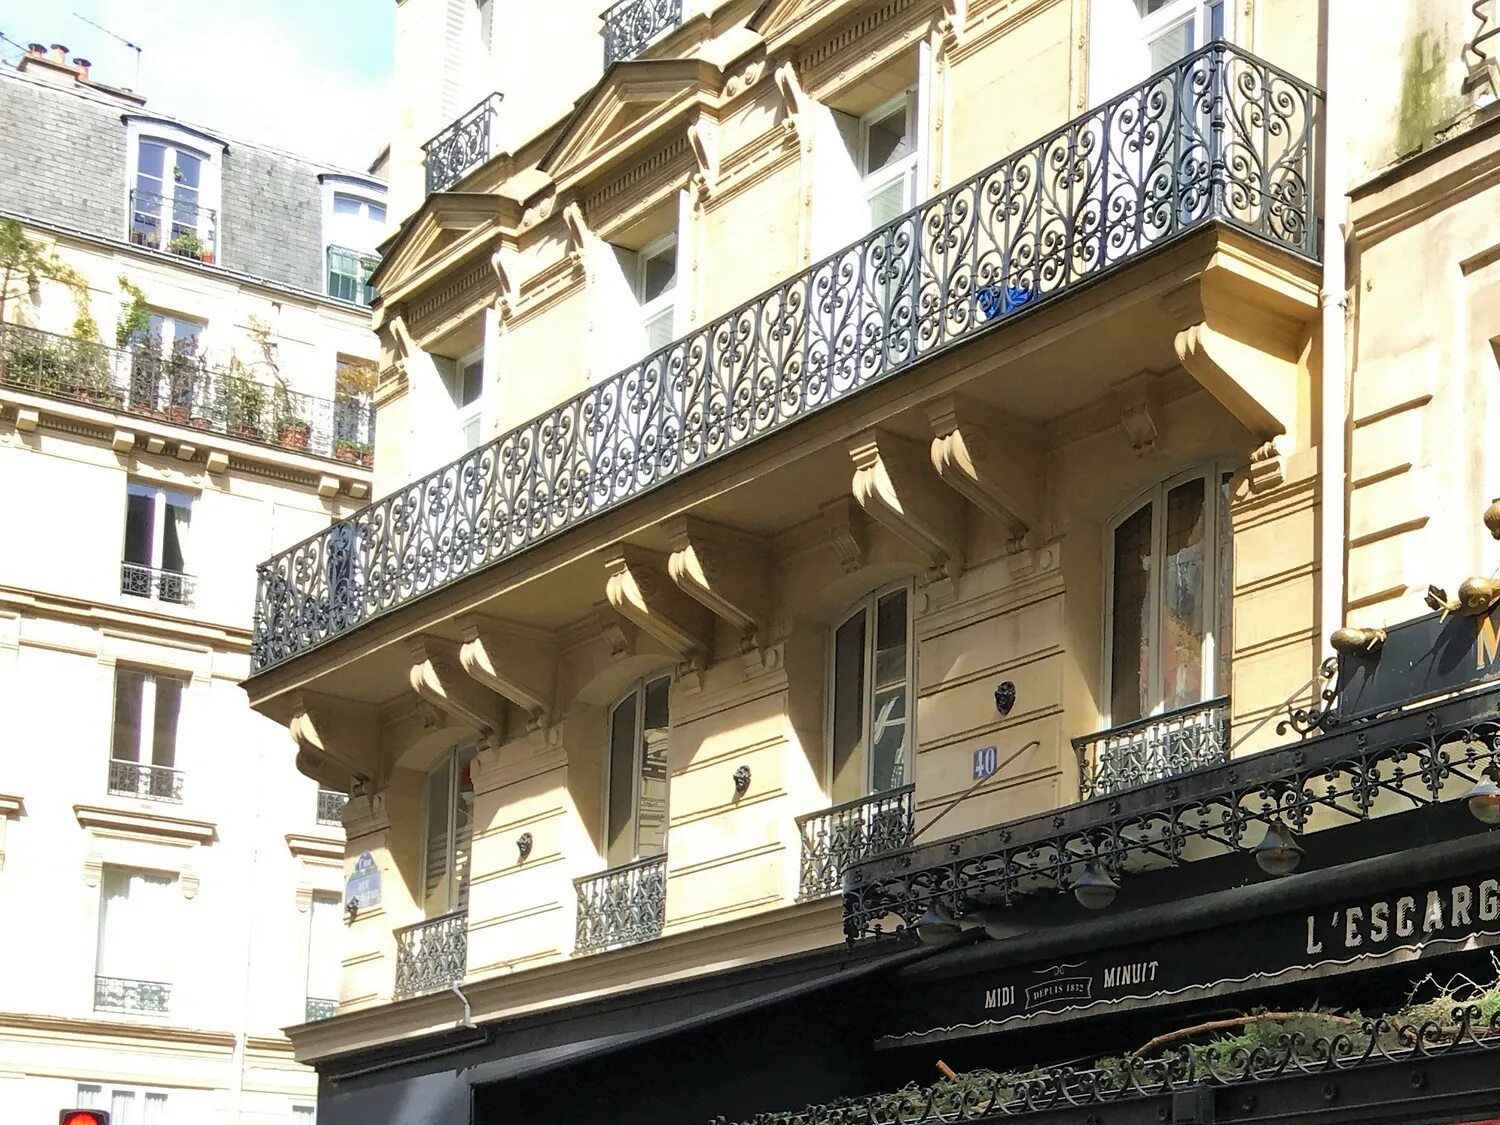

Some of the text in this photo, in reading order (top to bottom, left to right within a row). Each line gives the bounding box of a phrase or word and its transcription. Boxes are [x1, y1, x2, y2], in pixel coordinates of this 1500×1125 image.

[975, 747, 995, 776] 40
[984, 960, 1159, 1010] MIDI DEPUIS 1832 MINUIT
